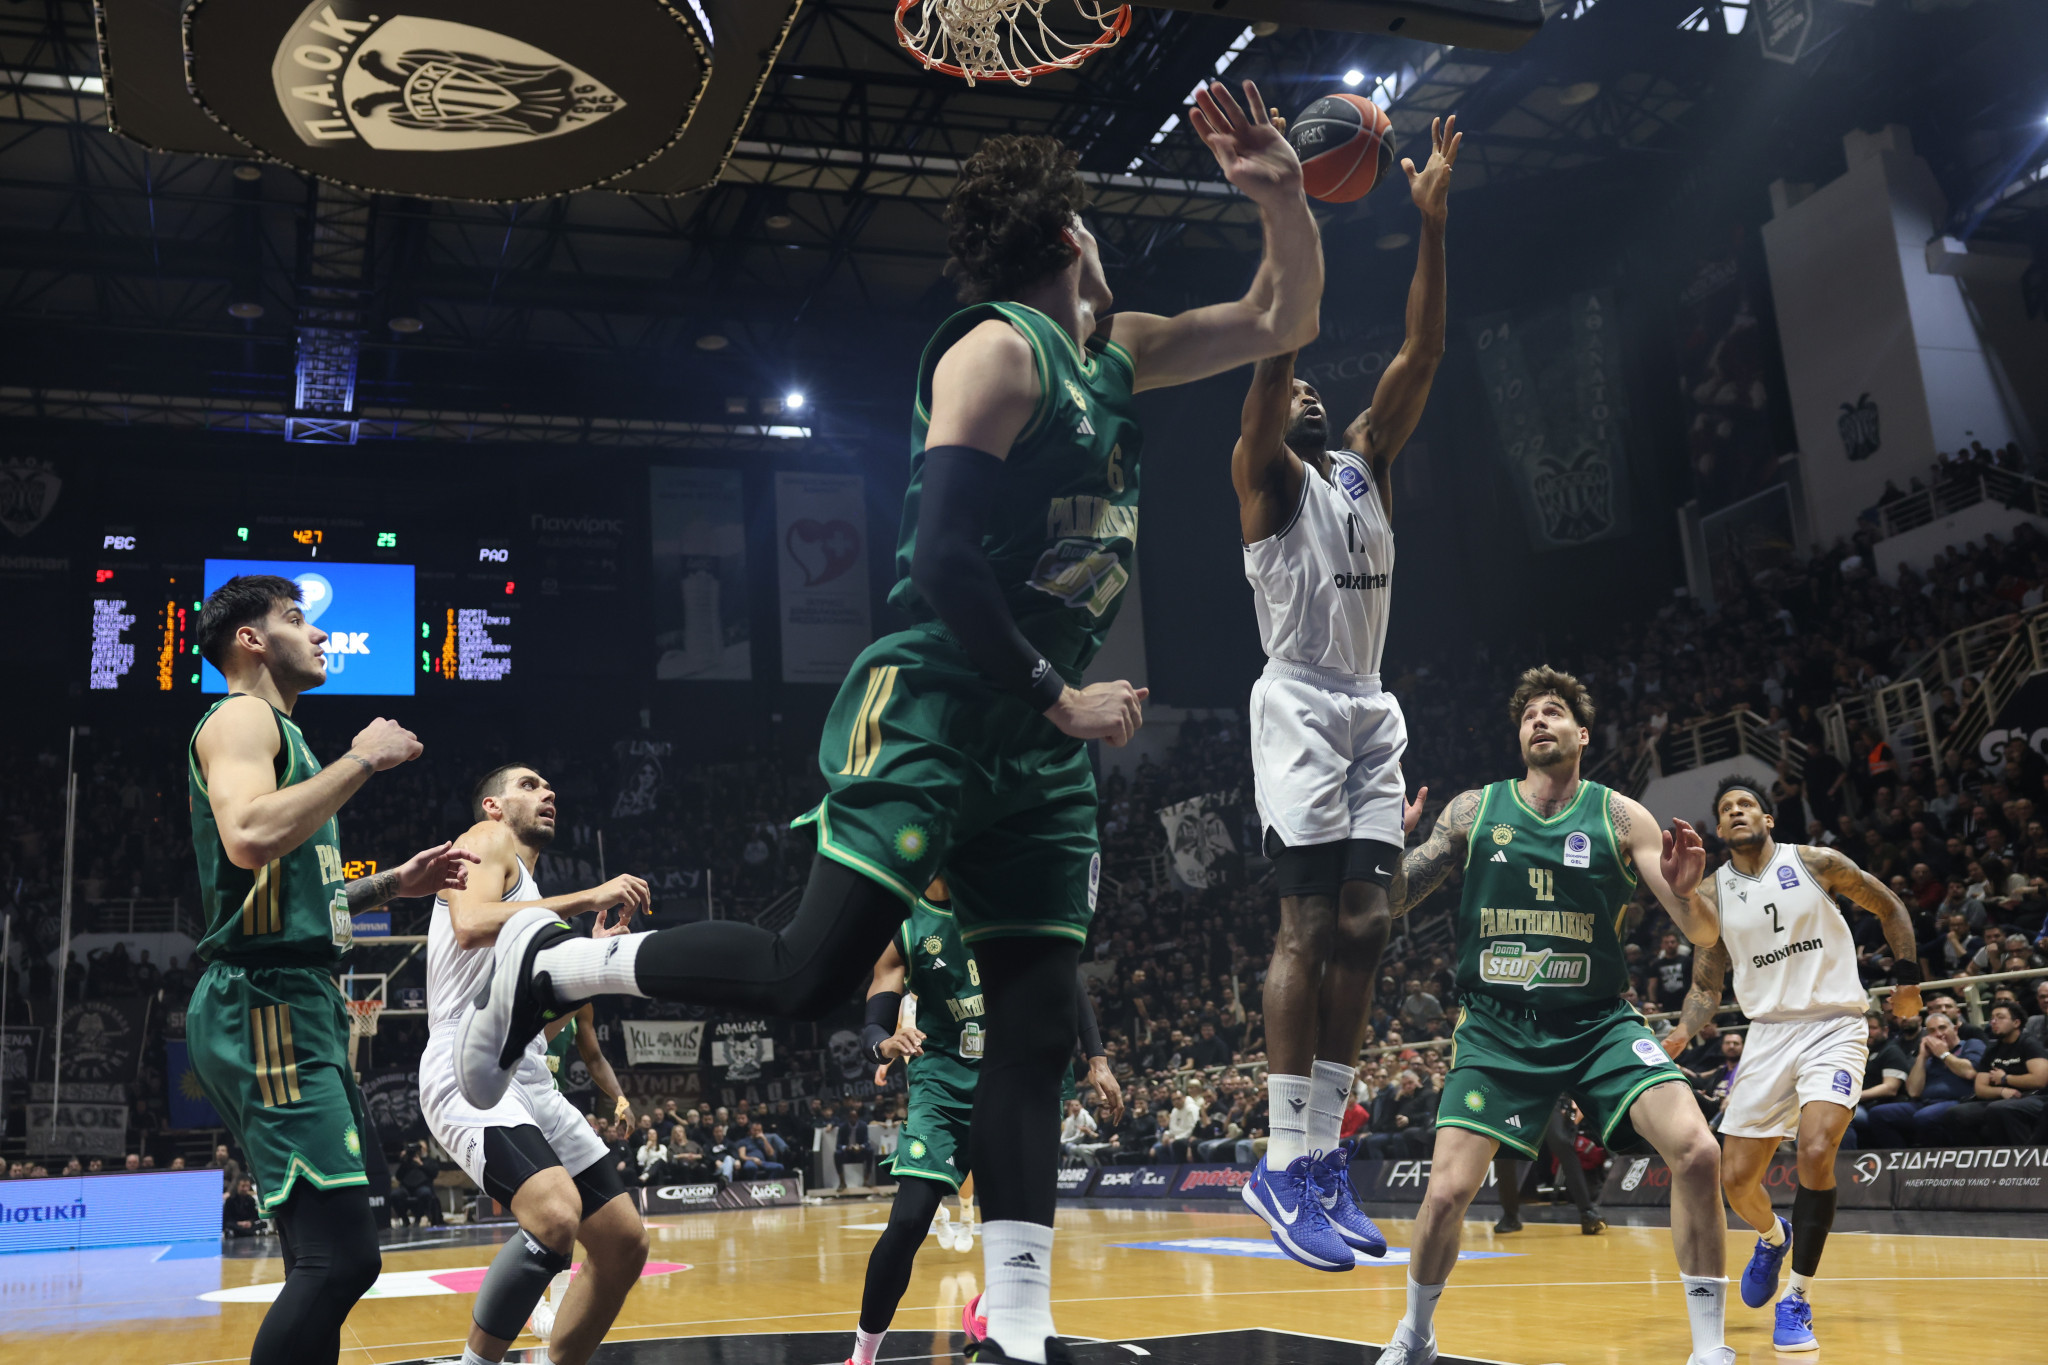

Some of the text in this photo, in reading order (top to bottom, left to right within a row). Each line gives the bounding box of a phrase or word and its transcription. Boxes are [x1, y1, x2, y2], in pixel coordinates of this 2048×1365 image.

[1108, 443, 1124, 493] 6
[237, 527, 248, 541] 9
[377, 532, 396, 547] 25
[103, 535, 137, 550] PBC
[479, 548, 509, 562] PAO
[505, 581, 515, 594] 2
[1528, 868, 1555, 901] 41
[1480, 908, 1595, 943] PANATHINAIKOS
[1764, 903, 1785, 933] 2
[1495, 946, 1520, 955] pame
[1752, 938, 1824, 968] Stoiximan
[967, 958, 980, 987] 8
[1905, 1178, 1966, 1188] ΗΛΕΚΤΡΟΛΟΓΙΚΟ
[1968, 1178, 1990, 1187] ΥΛΙΚΟ
[1999, 1177, 2041, 1187] ΦΩΤΙΣΜΟΣ
